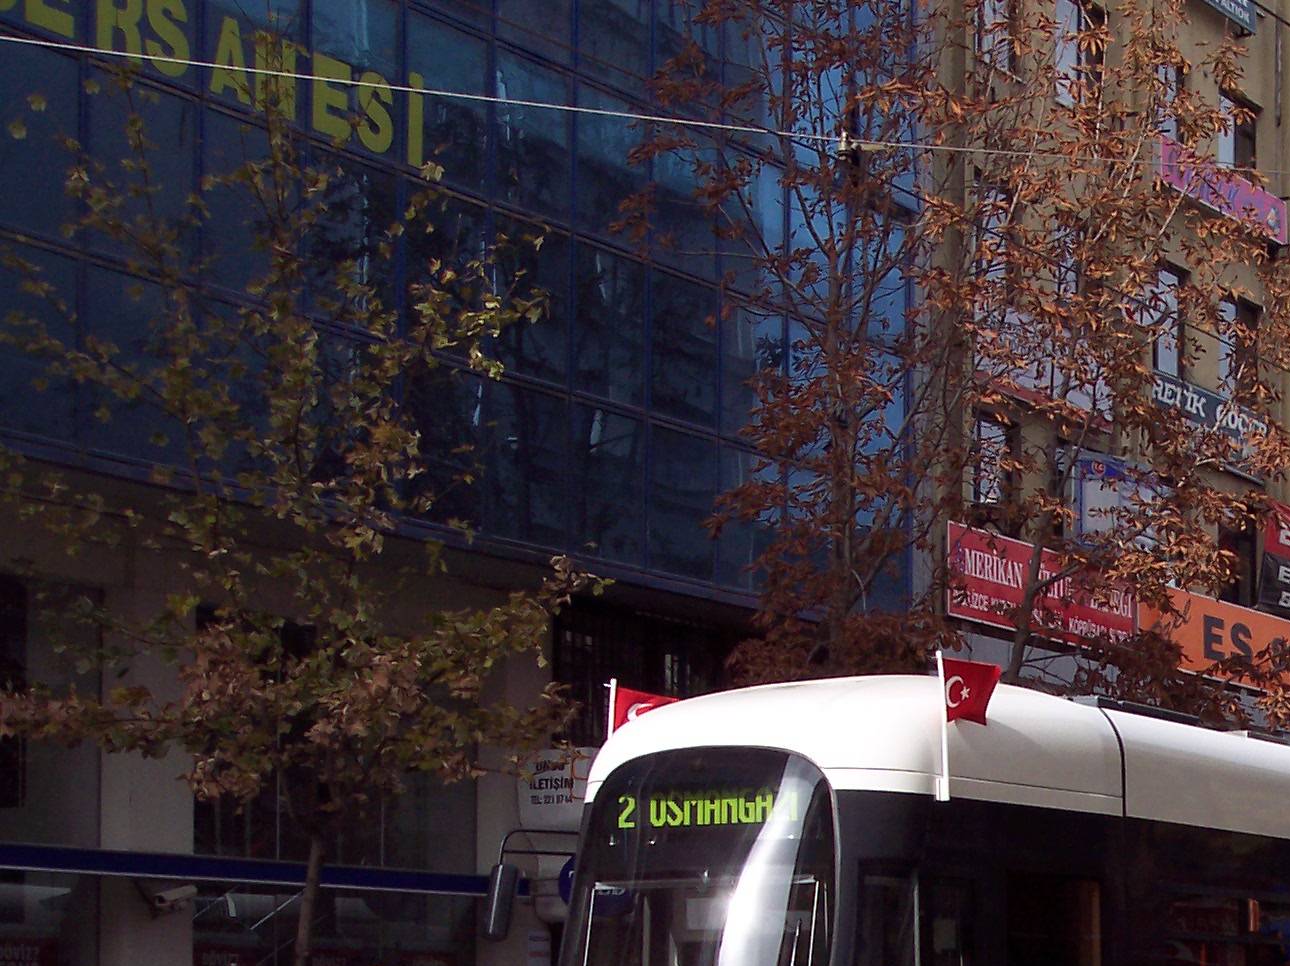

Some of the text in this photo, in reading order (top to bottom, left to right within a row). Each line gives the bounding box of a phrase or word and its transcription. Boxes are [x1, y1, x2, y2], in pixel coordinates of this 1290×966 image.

[956, 542, 1024, 589] MERİKAN
[1202, 613, 1252, 663] ES
[617, 796, 635, 828] 2
